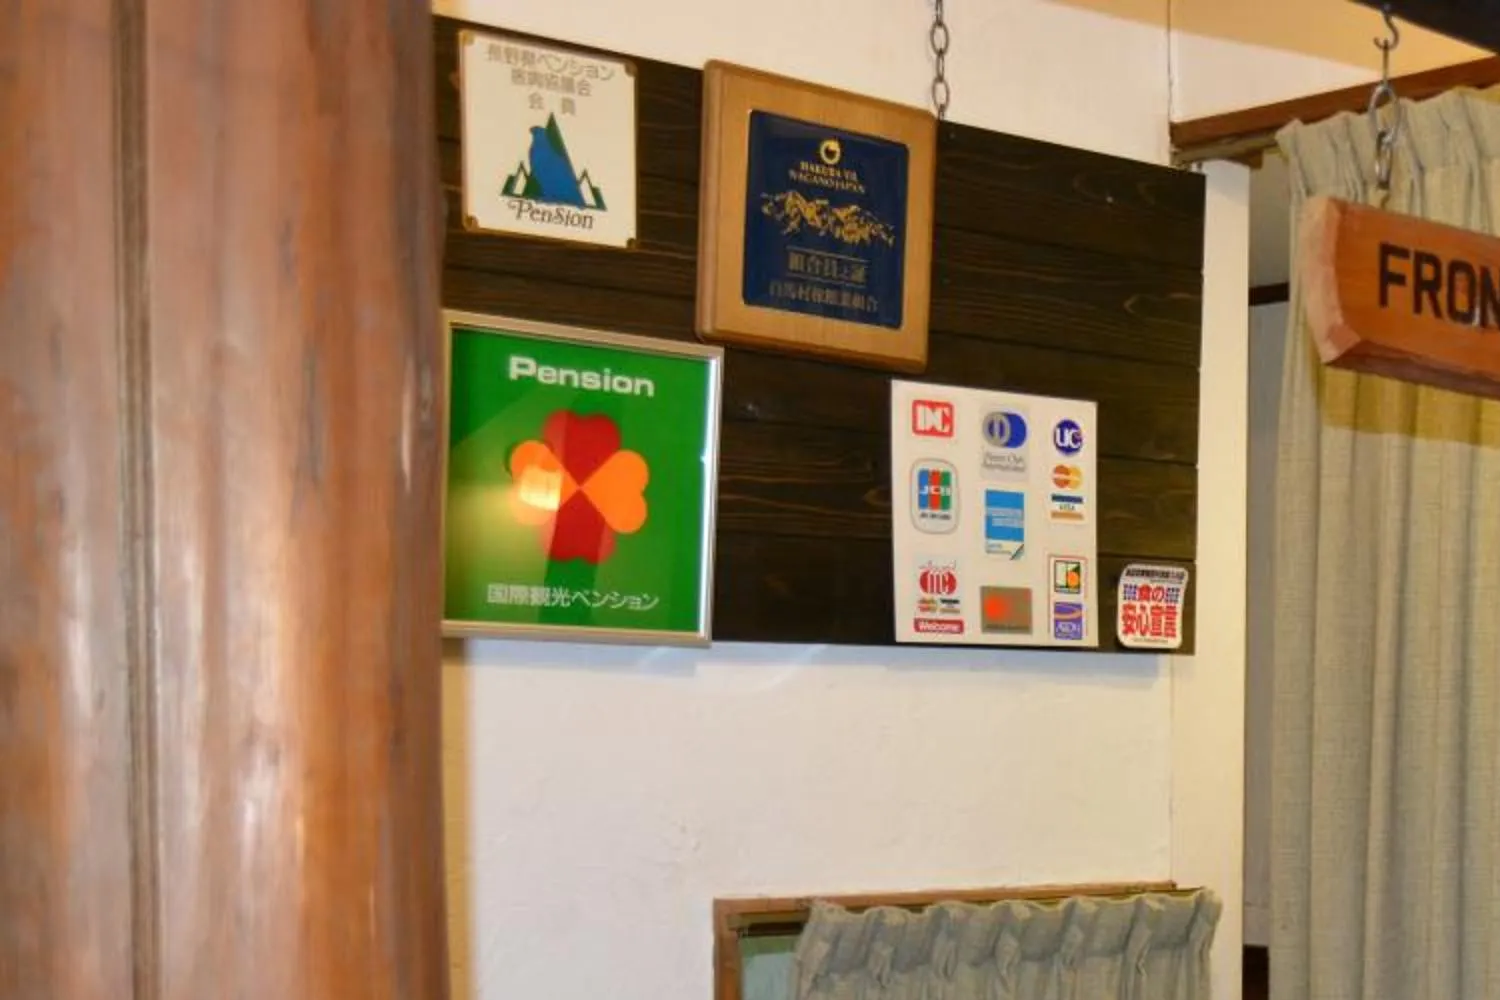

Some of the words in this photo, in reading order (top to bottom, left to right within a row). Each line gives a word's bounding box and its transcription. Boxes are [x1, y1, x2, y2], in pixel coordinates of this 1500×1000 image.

[509, 355, 655, 397] Pension
[1056, 427, 1081, 449] UC
[486, 583, 660, 611] 国際観光ペンション
